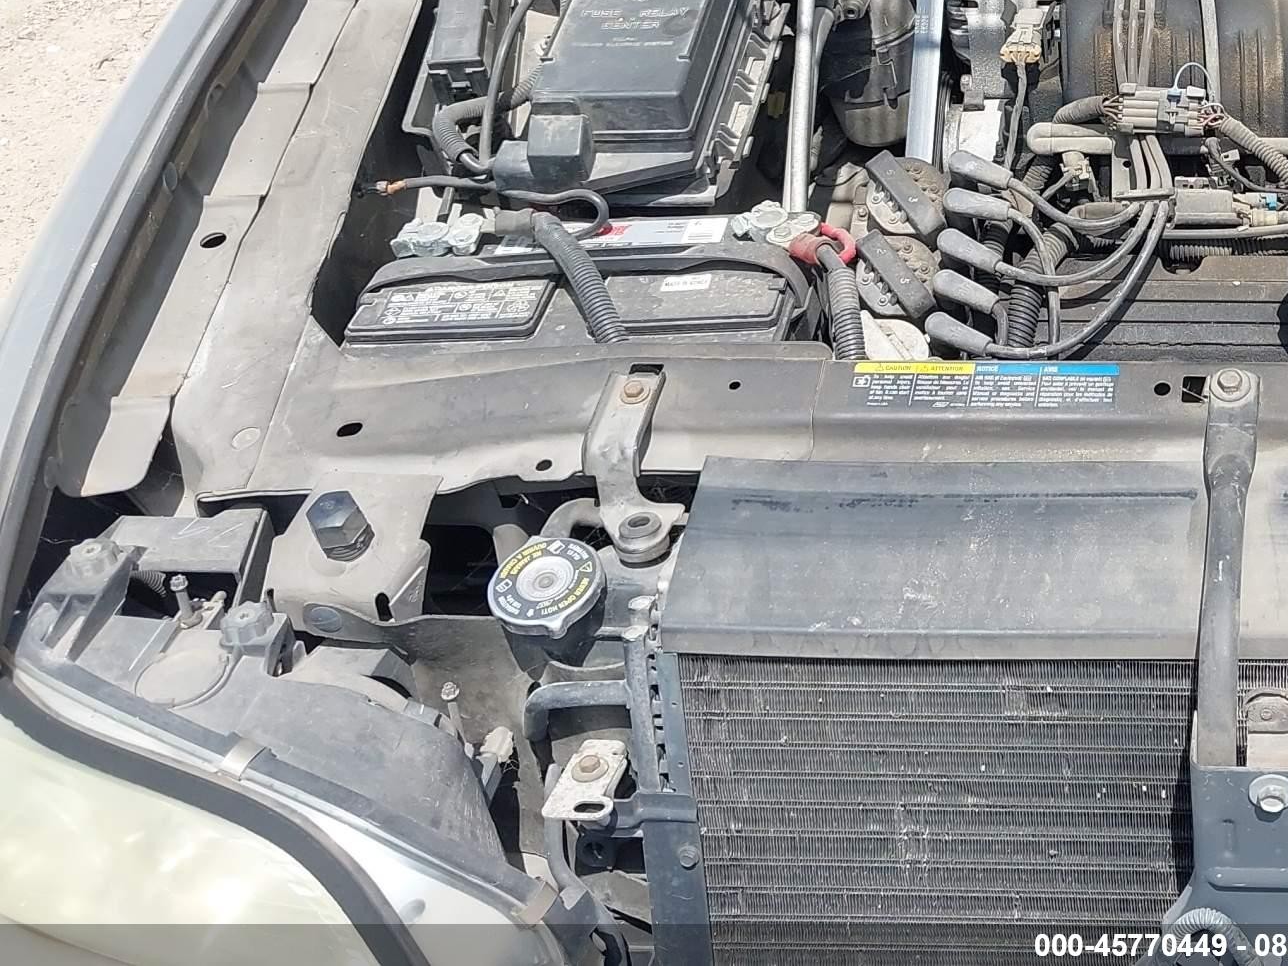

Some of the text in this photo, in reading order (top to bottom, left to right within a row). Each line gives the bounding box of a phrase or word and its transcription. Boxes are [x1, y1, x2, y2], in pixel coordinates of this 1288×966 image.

[639, 7, 689, 18] RELAY
[601, 20, 660, 30] CENTER
[574, 577, 590, 596] NEVER
[559, 595, 576, 610] OPEN
[541, 605, 558, 615] HOT!
